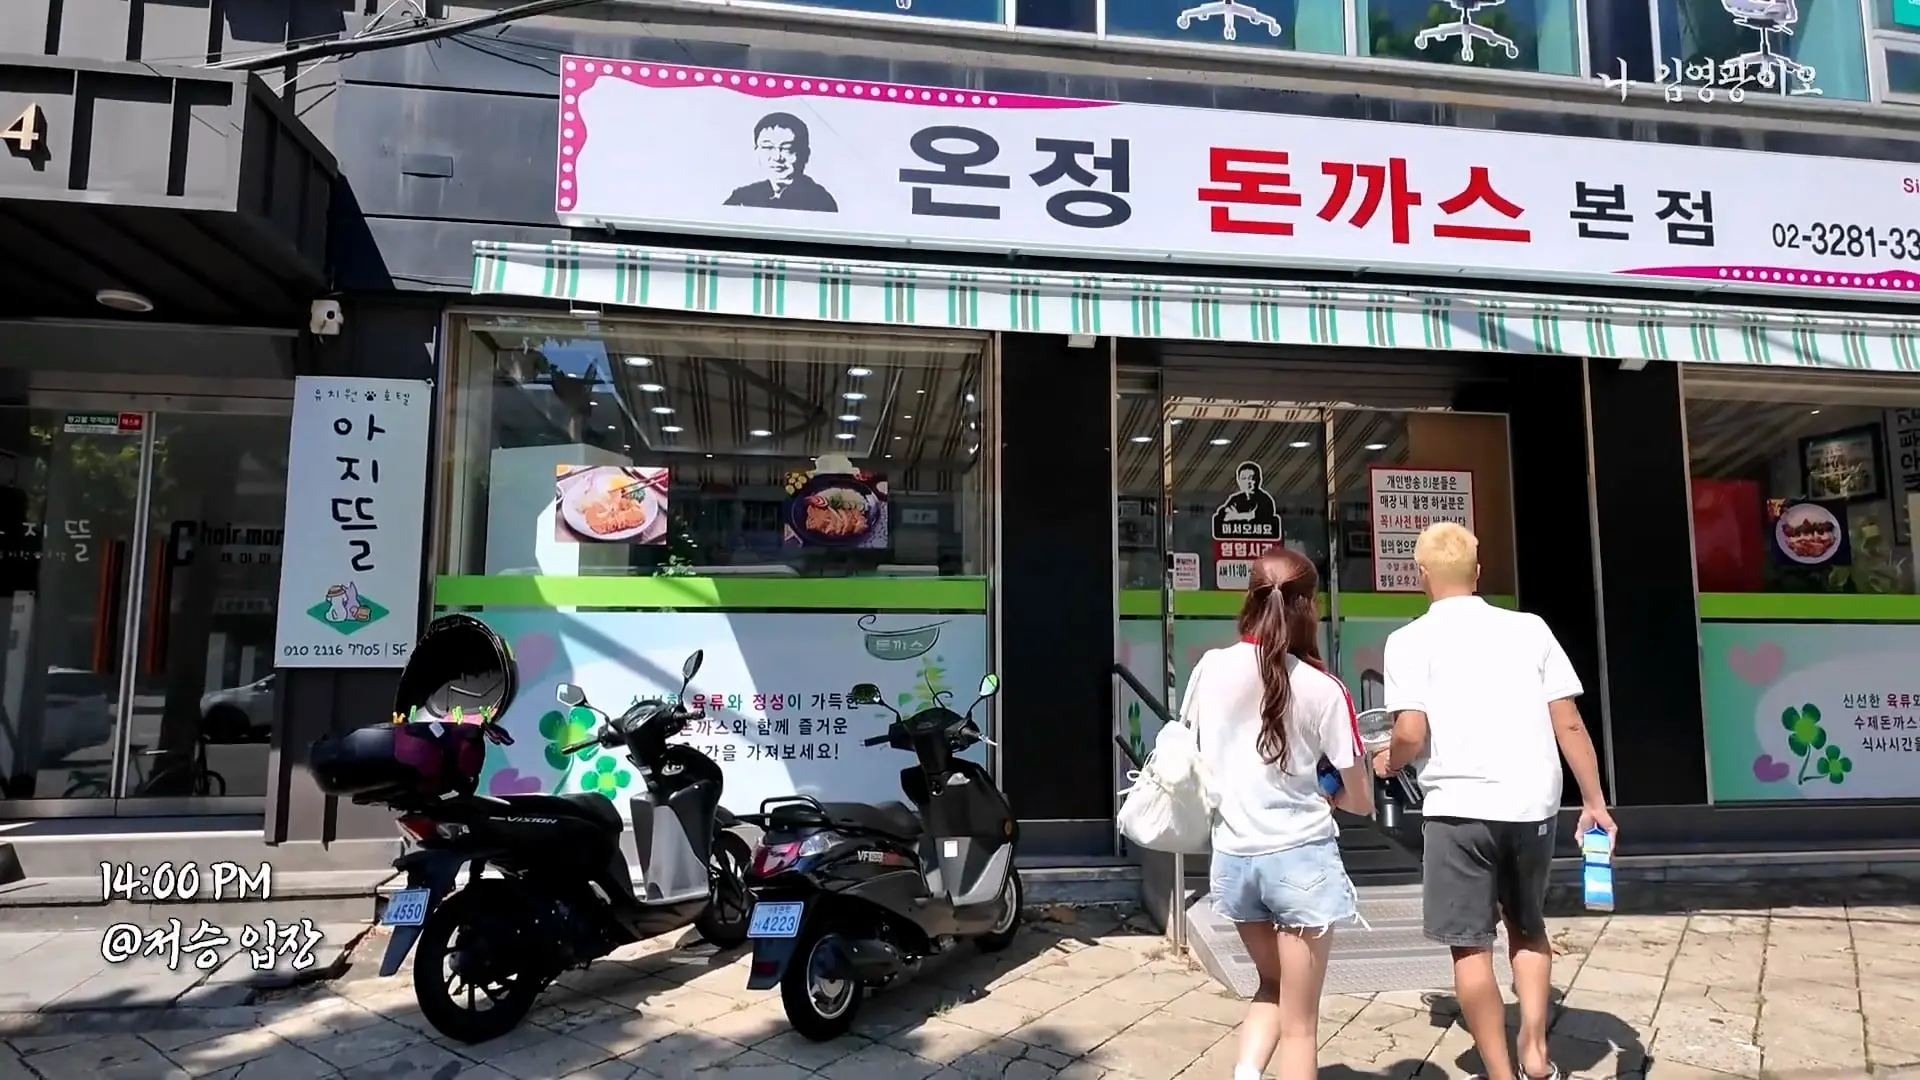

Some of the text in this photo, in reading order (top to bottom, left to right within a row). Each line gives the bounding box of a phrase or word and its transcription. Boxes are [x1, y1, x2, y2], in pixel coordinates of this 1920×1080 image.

[0, 103, 39, 150] 4
[899, 125, 1714, 247] 온정 돈까스 본점
[1387, 475, 1421, 490] 개인방송
[331, 414, 386, 571] 아지뜰
[1380, 495, 1397, 509] 매장
[1399, 495, 1408, 509] 내
[284, 645, 309, 657] 010
[313, 644, 343, 656] 2116
[348, 643, 380, 656] 7705
[692, 693, 743, 711] 육류와
[752, 693, 801, 711] 정성이
[1843, 693, 1880, 709] 신선한
[757, 717, 790, 737] 함께
[798, 716, 848, 736] 즐거운
[1854, 715, 1920, 730] 수제돈까스
[746, 742, 839, 761] 가져보세요!
[394, 903, 422, 920] 4550
[762, 916, 796, 932] 4223
